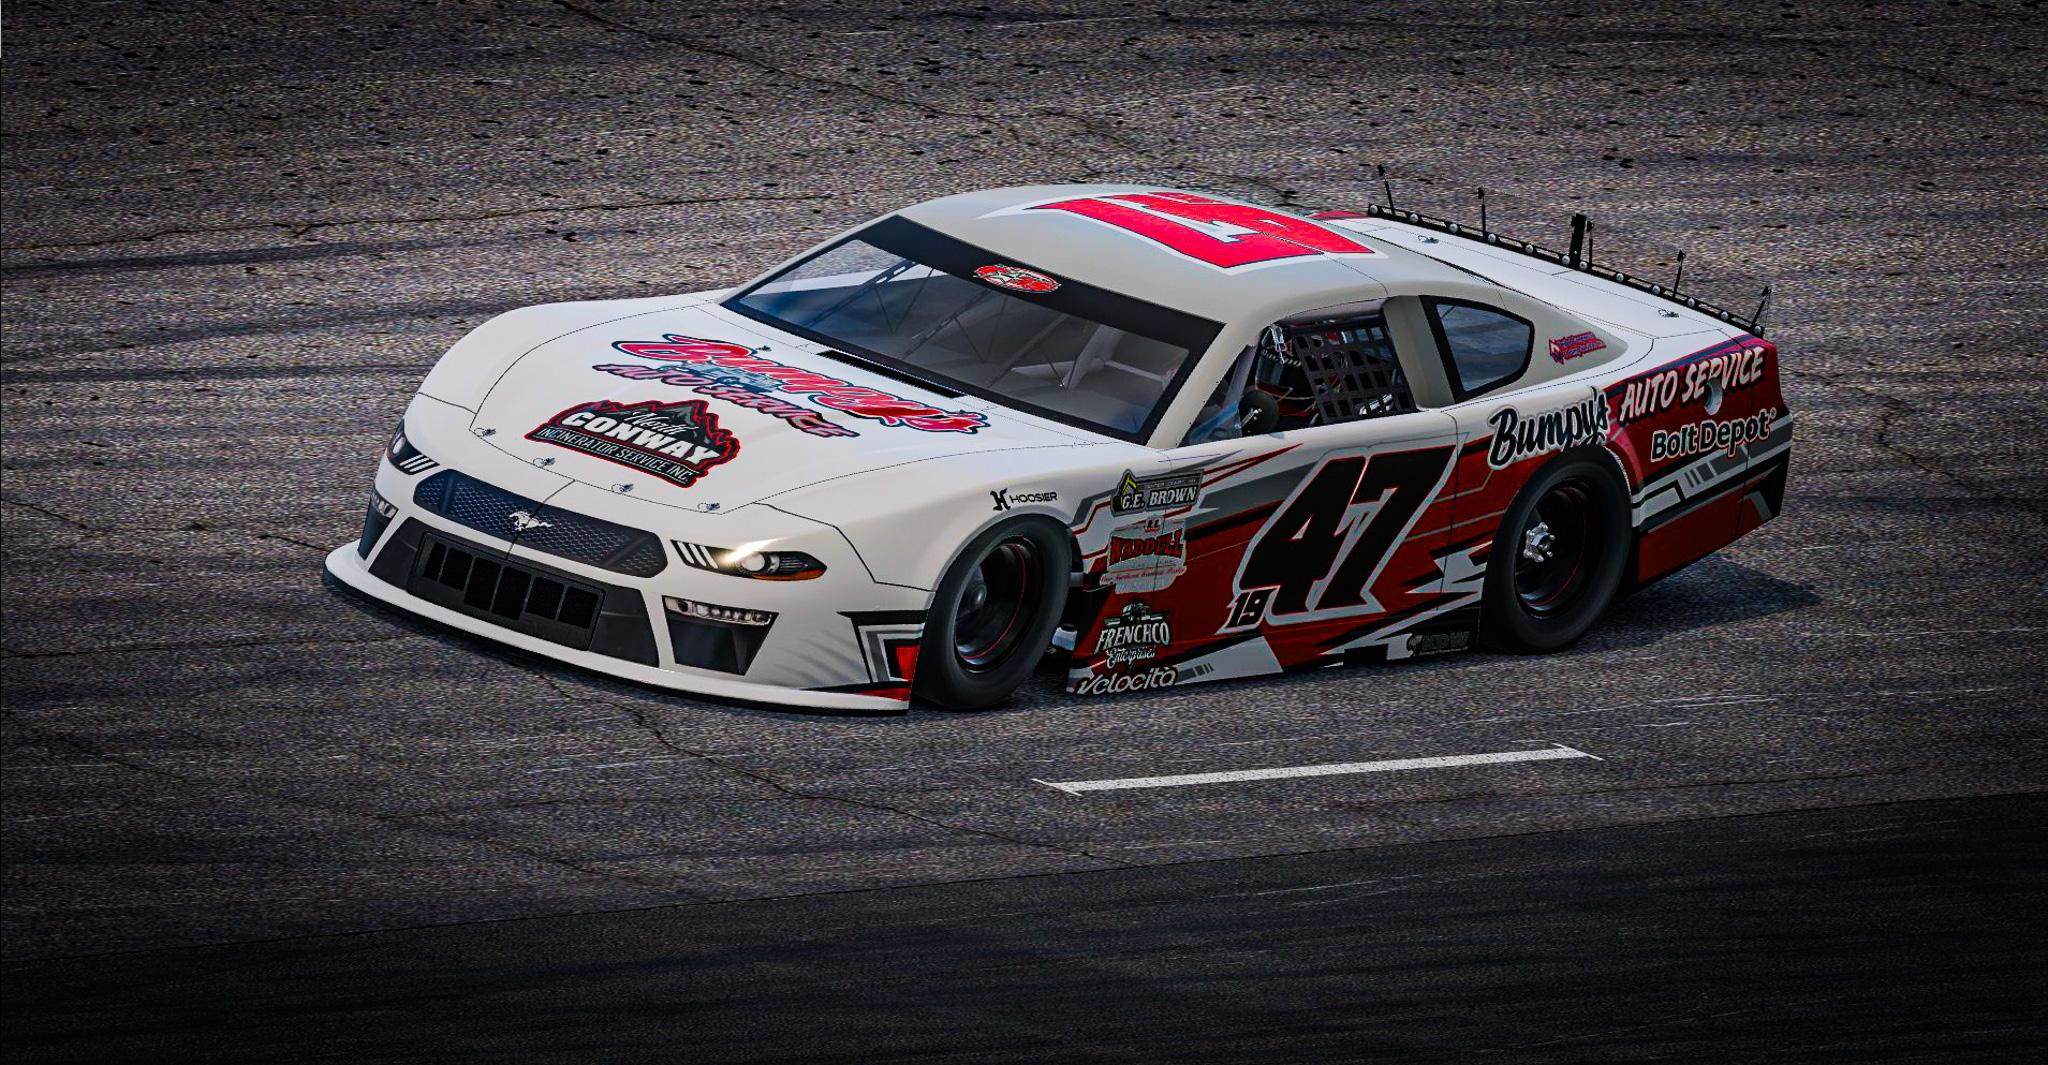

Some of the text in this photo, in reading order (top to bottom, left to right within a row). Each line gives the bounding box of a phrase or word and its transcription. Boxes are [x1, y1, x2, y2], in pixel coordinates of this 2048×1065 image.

[592, 364, 860, 438] AUTO SERVICE
[612, 333, 989, 434] Bumpy's
[1619, 370, 1678, 422] AUTO
[561, 412, 720, 464] CONWAY
[620, 411, 699, 435] North
[1489, 386, 1608, 466] Bumpy's
[1651, 424, 1697, 462] Bolt
[538, 428, 613, 454] INCINERATOR
[616, 448, 667, 471] SERVICE
[1009, 491, 1058, 503] HOOSIER
[1122, 486, 1198, 510] G.E. BROWN
[1238, 444, 1457, 617] 47
[1222, 588, 1277, 629] 19
[1094, 622, 1170, 654] FRENCHCO
